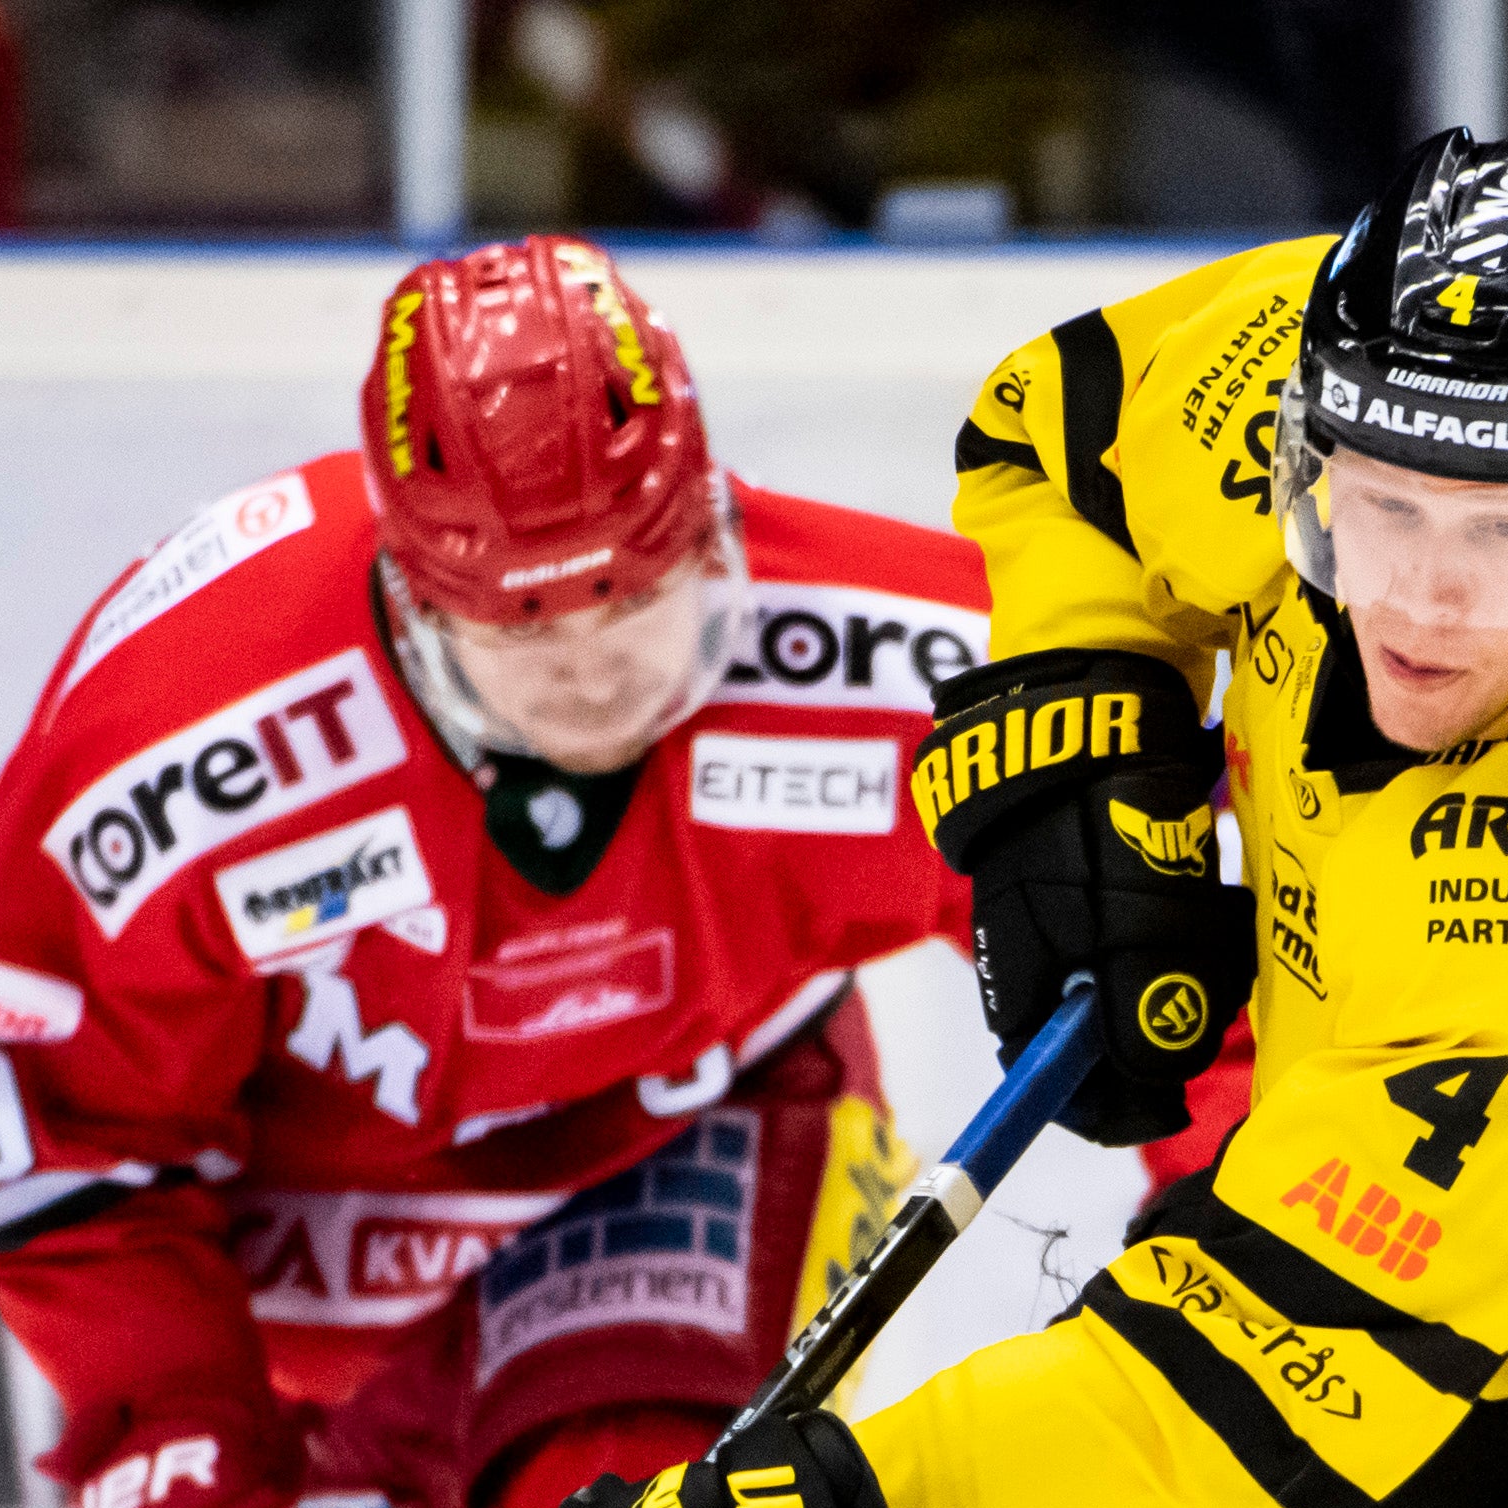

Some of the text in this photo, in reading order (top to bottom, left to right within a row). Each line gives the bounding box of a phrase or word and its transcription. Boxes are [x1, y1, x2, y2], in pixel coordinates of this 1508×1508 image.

[1435, 273, 1481, 327] 4
[1181, 294, 1289, 433] PARTNER
[1279, 1158, 1443, 1282] ABB
